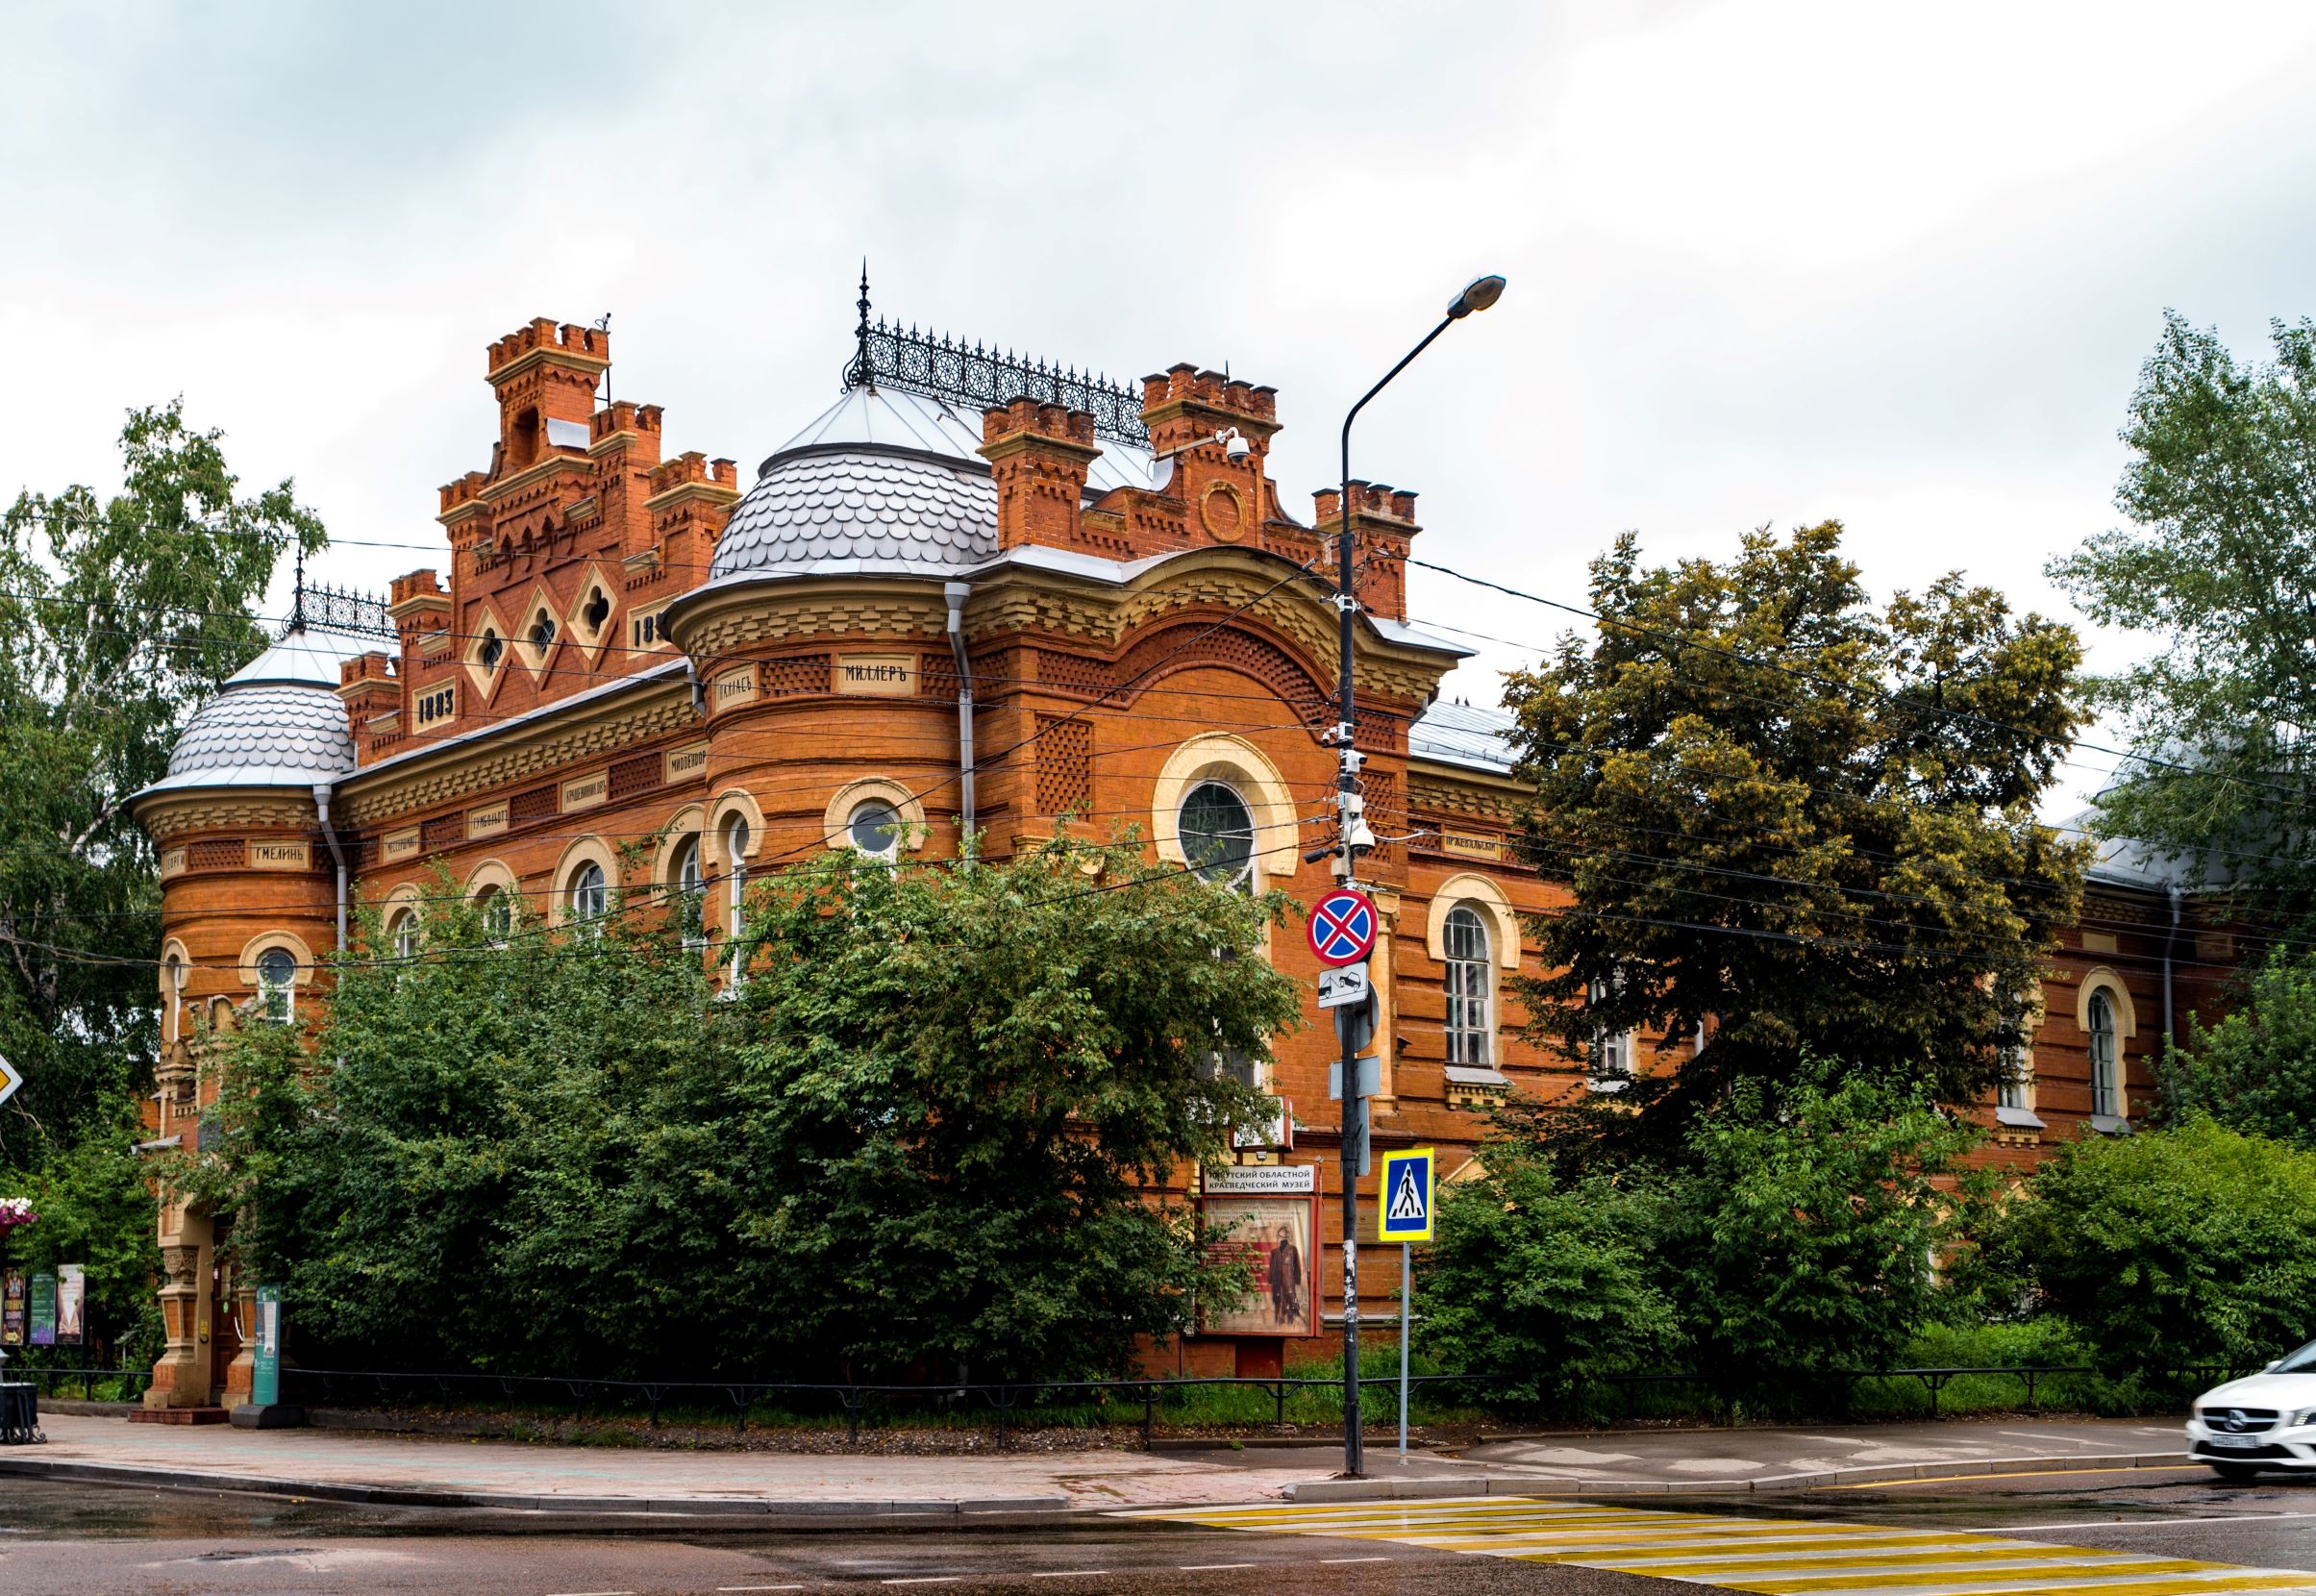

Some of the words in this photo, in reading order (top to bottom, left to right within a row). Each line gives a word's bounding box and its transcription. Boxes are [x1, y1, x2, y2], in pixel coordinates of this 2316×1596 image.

[846, 665, 906, 682] МИЛЛЕРЪ
[418, 688, 454, 724] 1883
[1259, 1170, 1310, 1179] ОБЛАСТНОЙ
[1282, 1180, 1310, 1188] МУЗЕЙ
